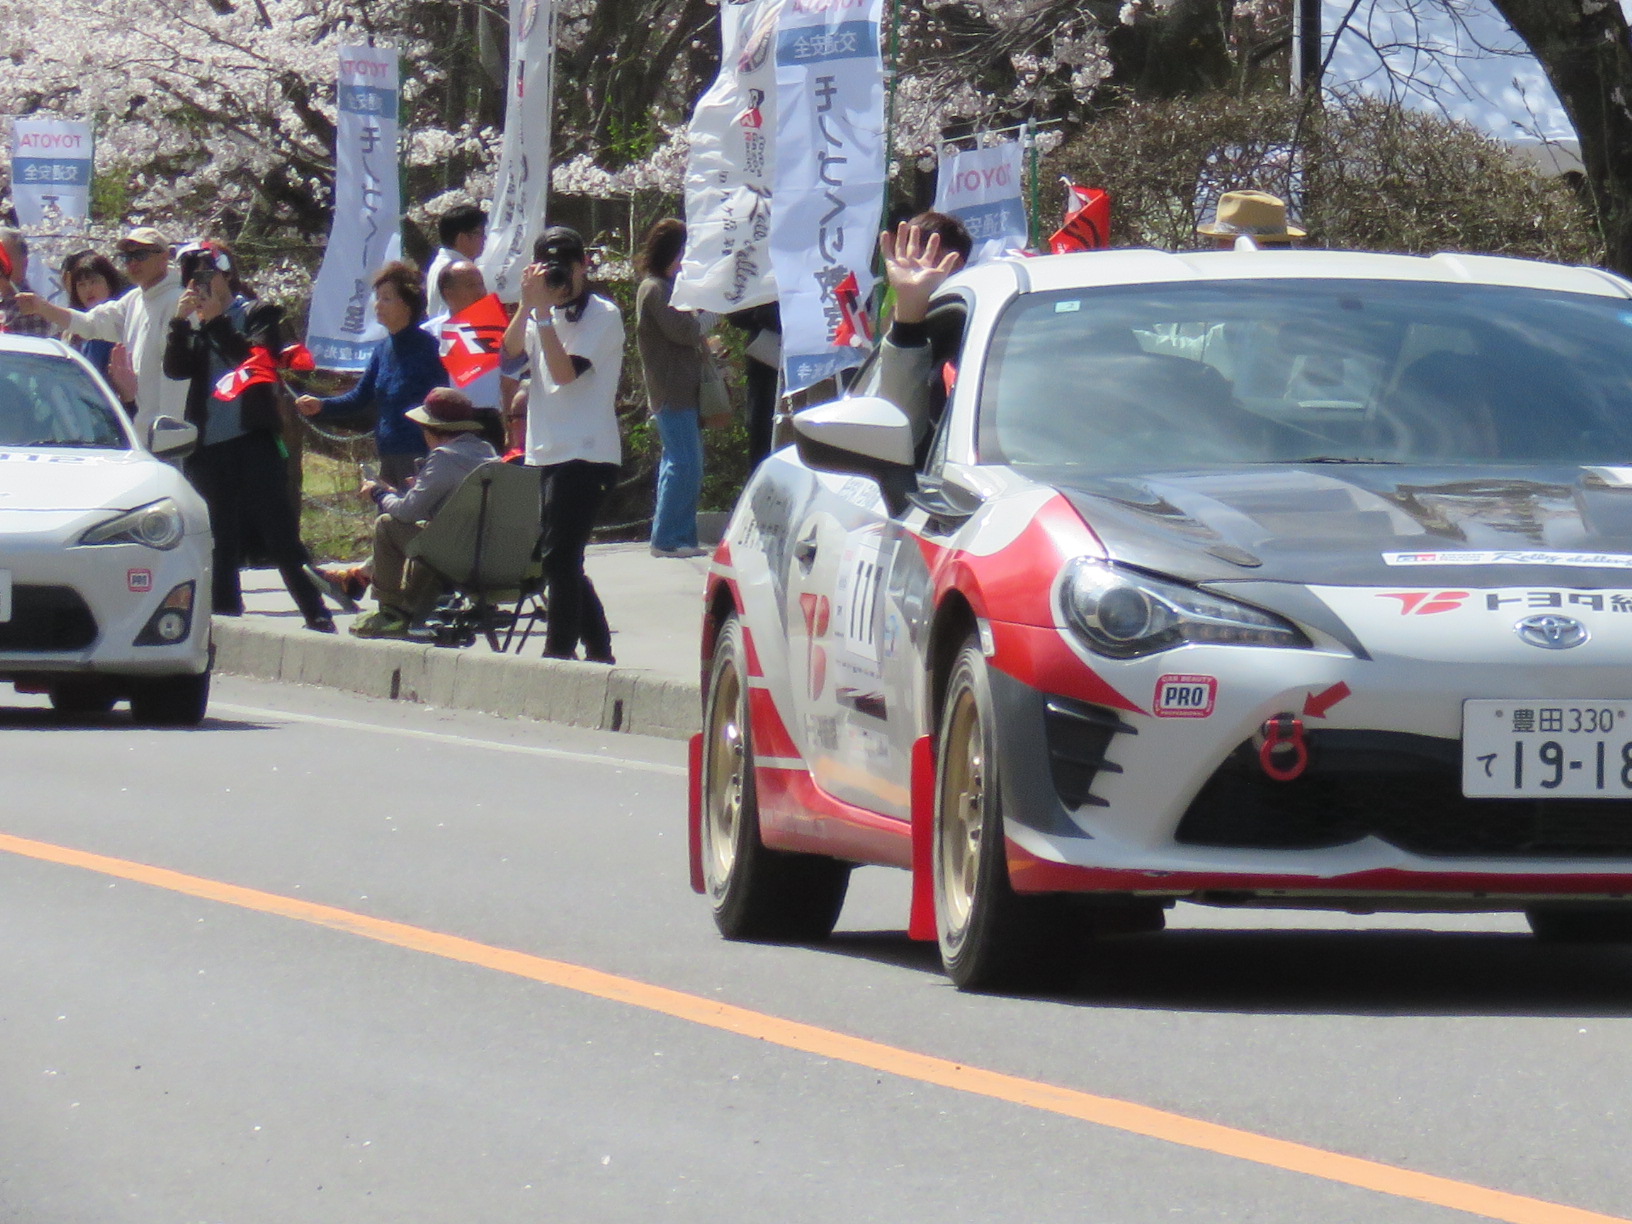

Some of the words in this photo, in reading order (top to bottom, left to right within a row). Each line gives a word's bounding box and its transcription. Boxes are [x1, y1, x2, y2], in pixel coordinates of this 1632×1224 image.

[850, 560, 883, 645] 111
[1163, 686, 1204, 707] PRO
[1476, 753, 1497, 777] て
